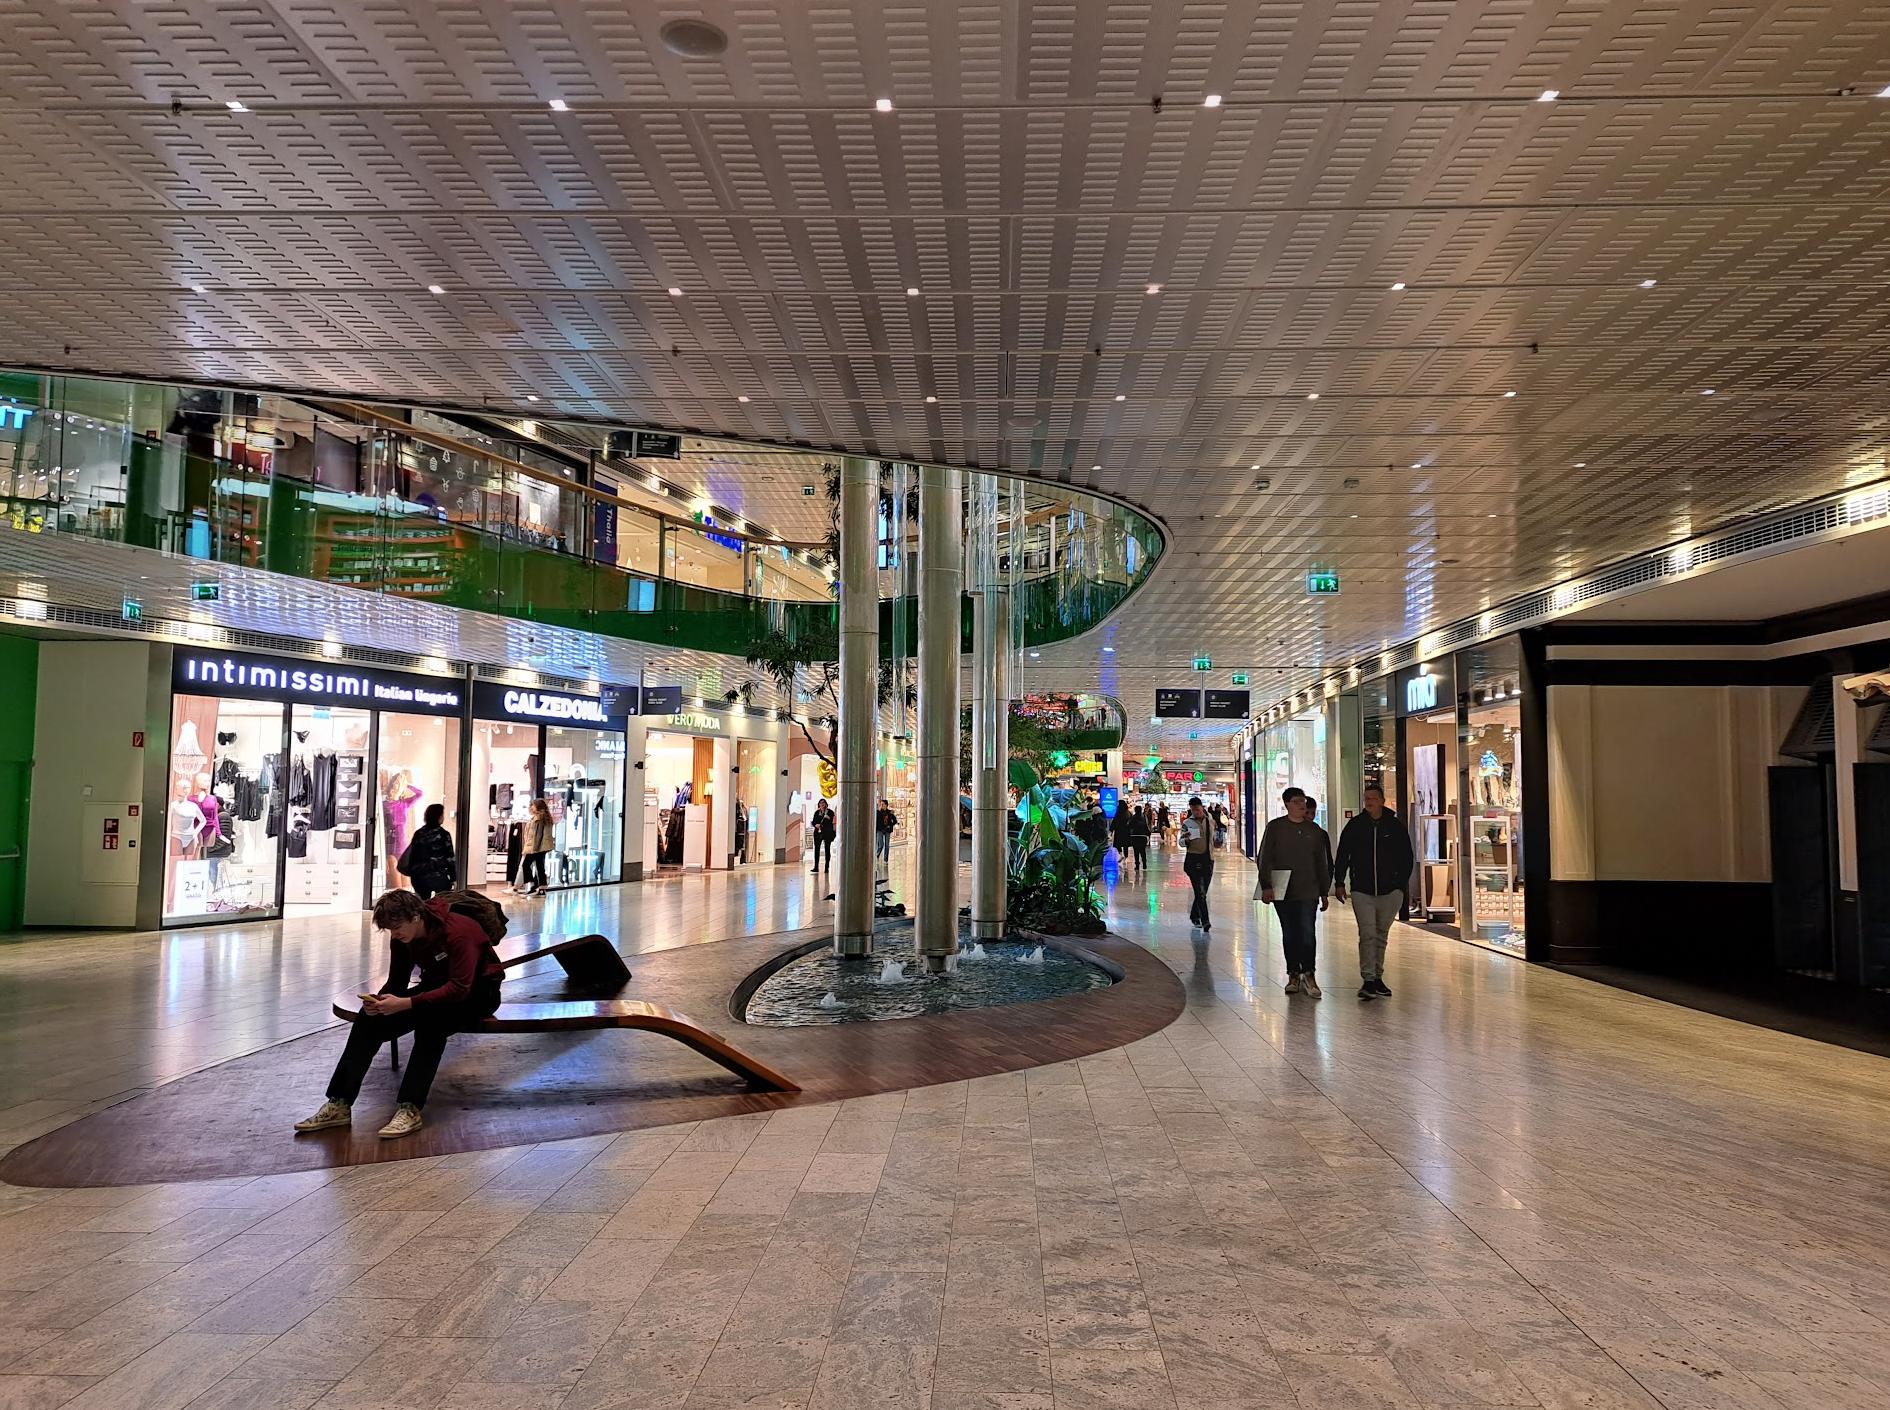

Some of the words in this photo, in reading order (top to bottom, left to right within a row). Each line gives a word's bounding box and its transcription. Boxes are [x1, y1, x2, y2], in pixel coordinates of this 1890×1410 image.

[188, 659, 369, 697] intimissimi
[374, 684, 413, 701] Italian
[667, 713, 693, 727] VERO
[694, 715, 721, 730] MODA
